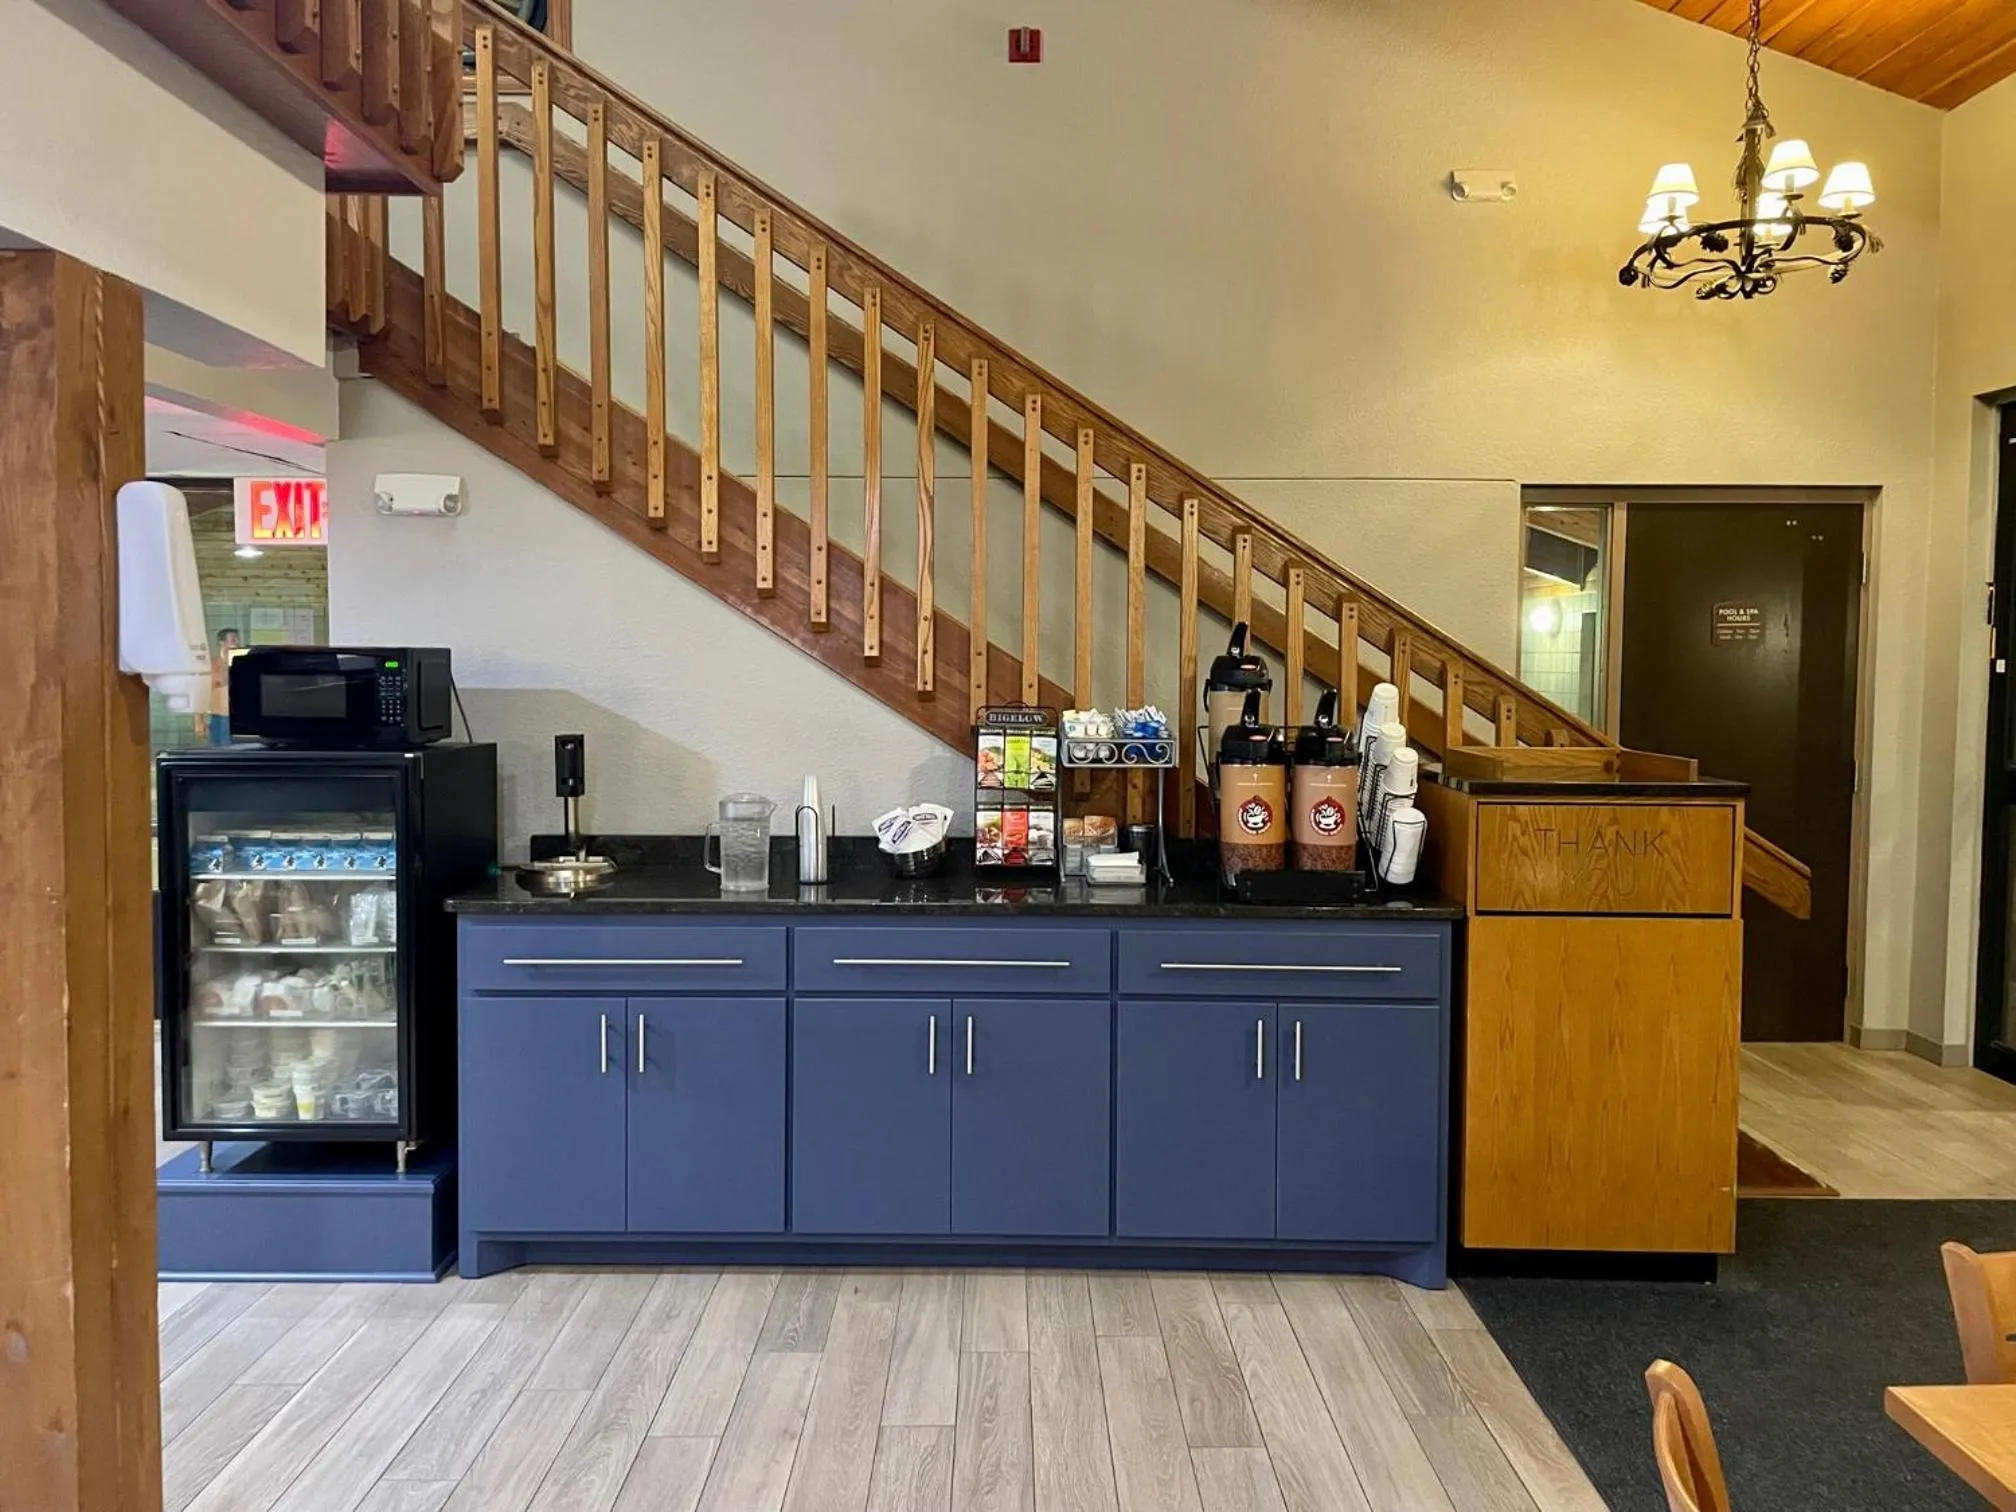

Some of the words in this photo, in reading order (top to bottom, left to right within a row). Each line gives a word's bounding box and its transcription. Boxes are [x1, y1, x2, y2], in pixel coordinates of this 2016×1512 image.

[251, 481, 325, 539] EXIT
[1718, 608, 1737, 616] POOL
[988, 713, 1043, 723] BIGELOW
[1535, 828, 1666, 857] THANK
